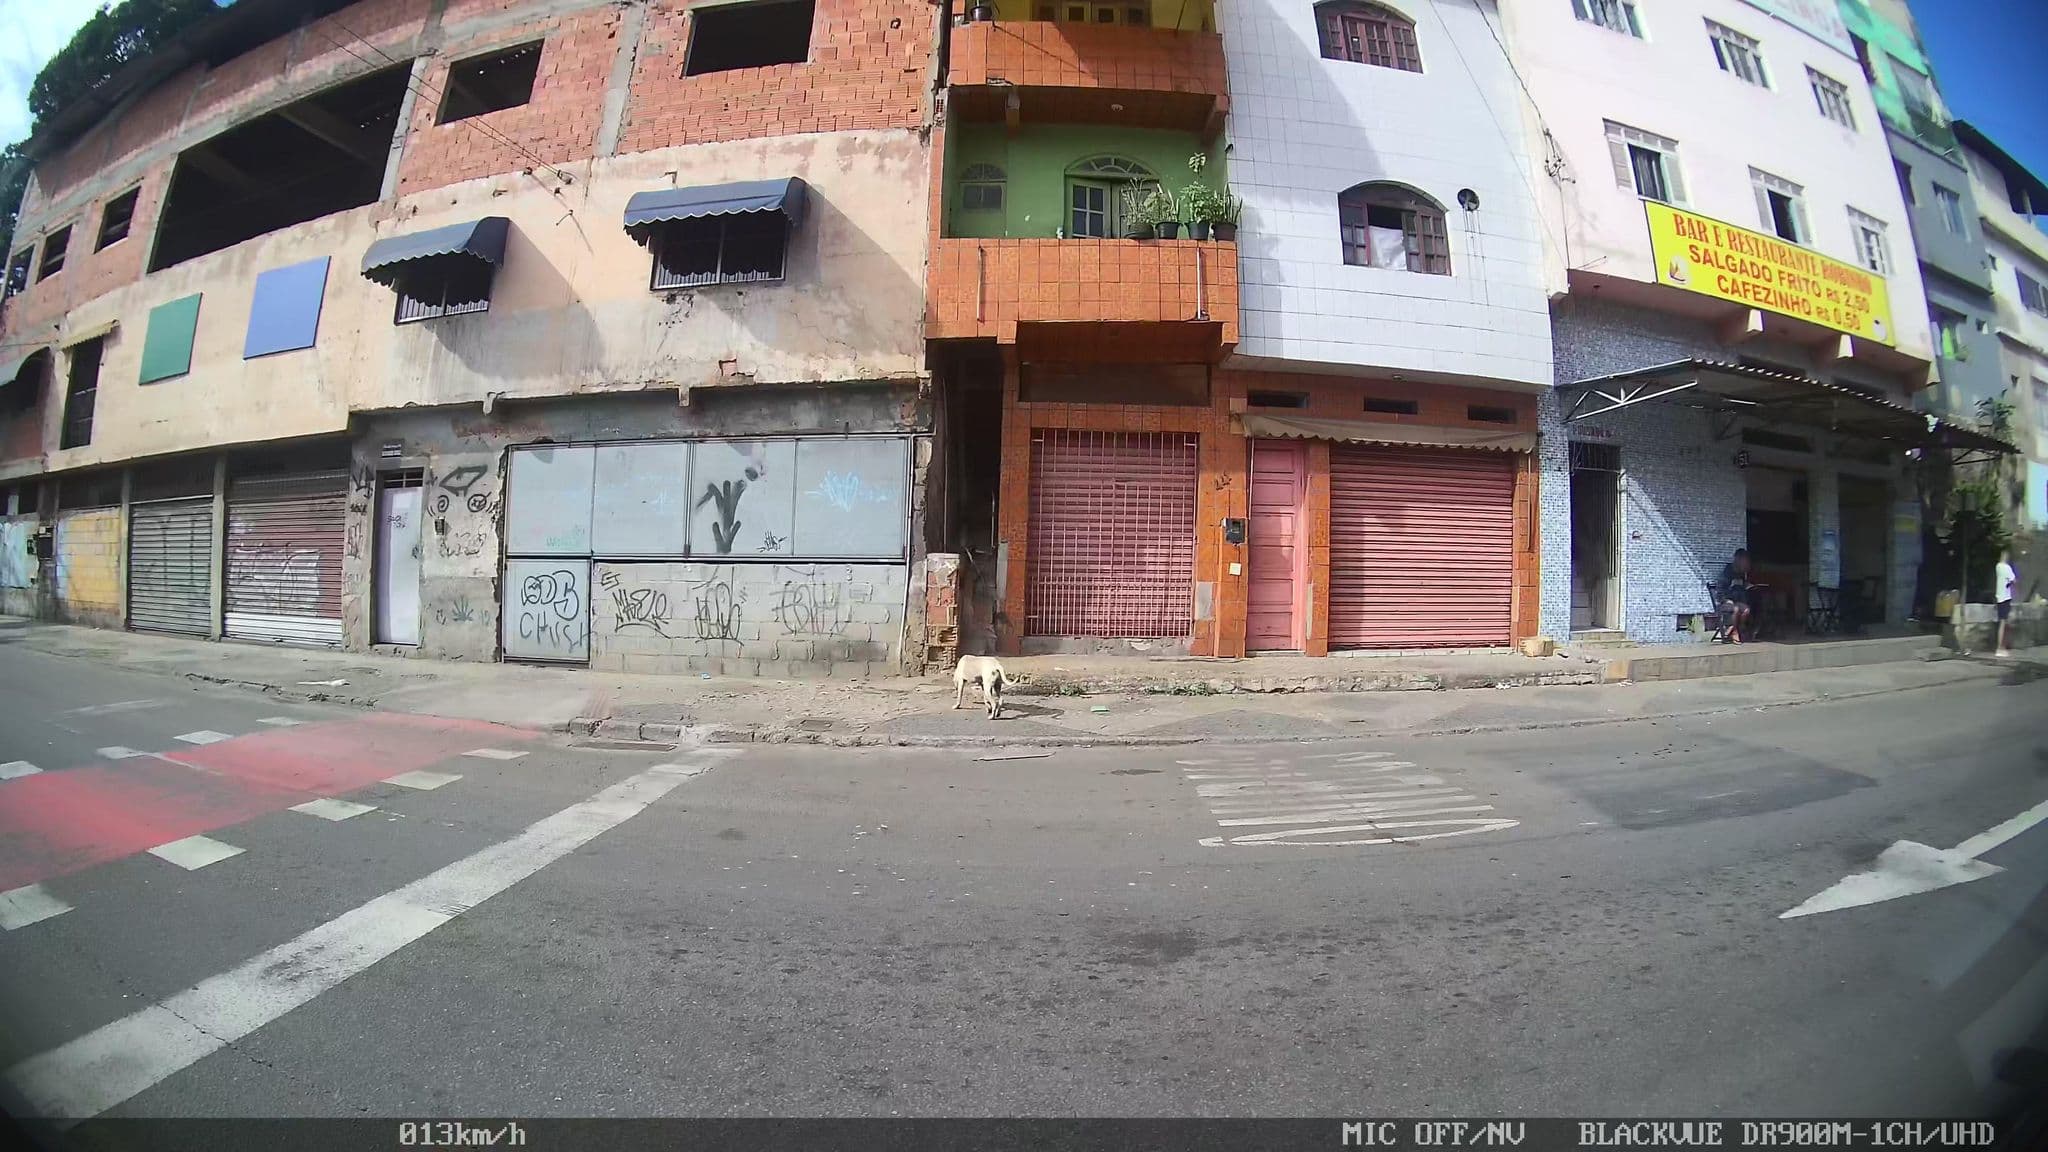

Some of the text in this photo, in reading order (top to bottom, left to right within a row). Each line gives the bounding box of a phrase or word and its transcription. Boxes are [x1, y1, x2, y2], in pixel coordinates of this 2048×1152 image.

[1672, 213, 1818, 277] BAR E RESTAURANTE
[1689, 244, 1772, 283] SALGADO
[1778, 271, 1821, 298] FRITO
[1717, 275, 1812, 316] CAFEZINHO
